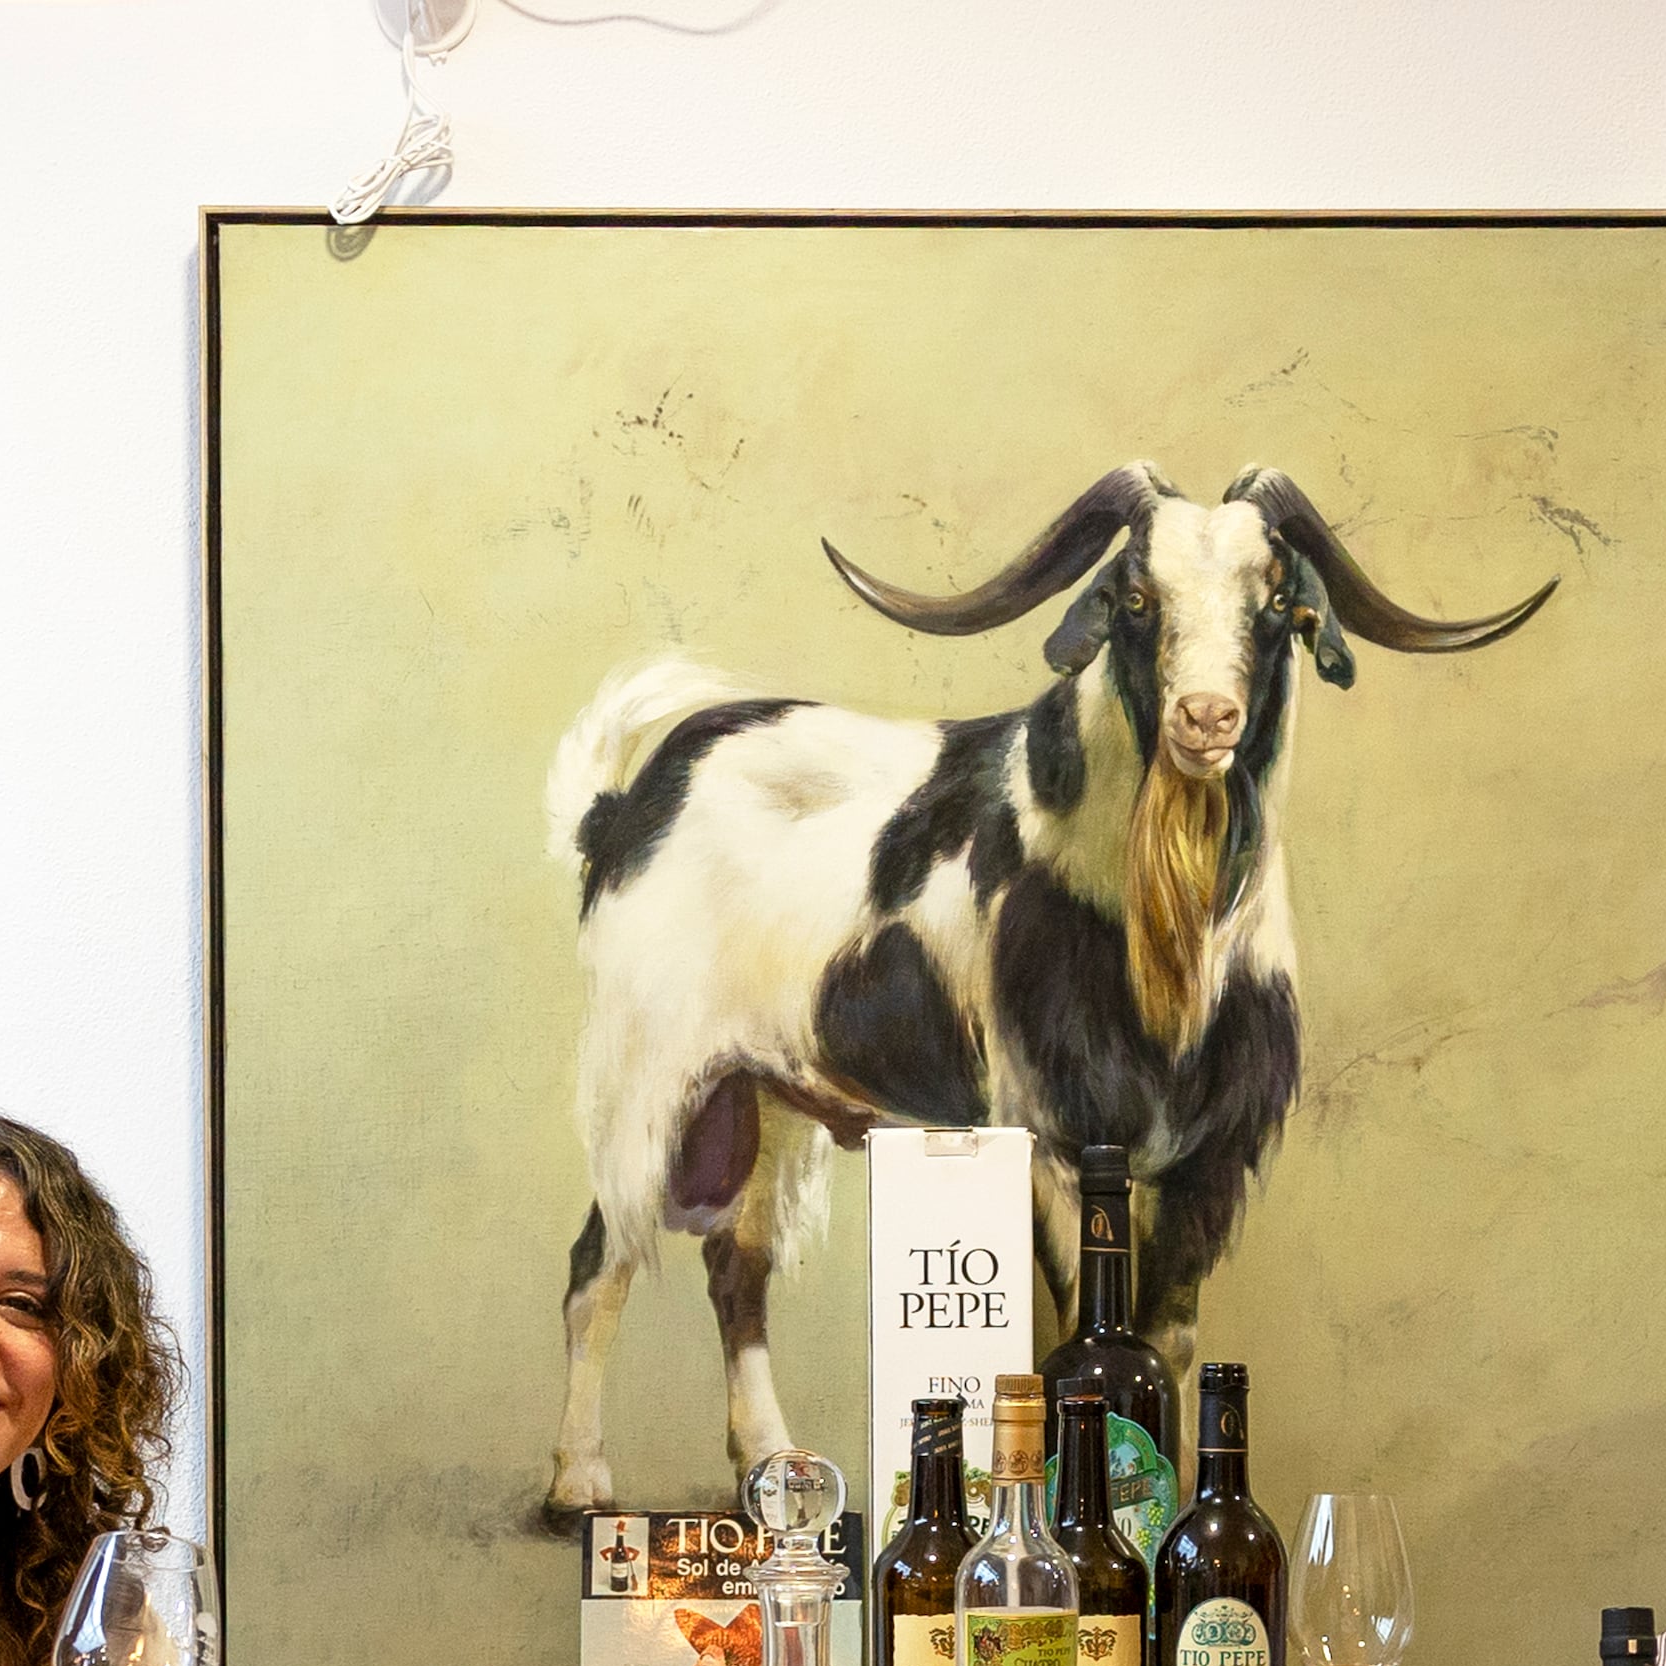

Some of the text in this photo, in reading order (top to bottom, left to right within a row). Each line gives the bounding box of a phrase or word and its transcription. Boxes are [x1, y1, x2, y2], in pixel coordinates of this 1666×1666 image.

[909, 1239, 999, 1286] TÍO
[899, 1292, 1010, 1329] PEPE
[928, 1375, 981, 1394] FINO
[666, 1518, 745, 1554] TIO
[677, 1558, 709, 1577] Sol
[716, 1558, 741, 1577] de
